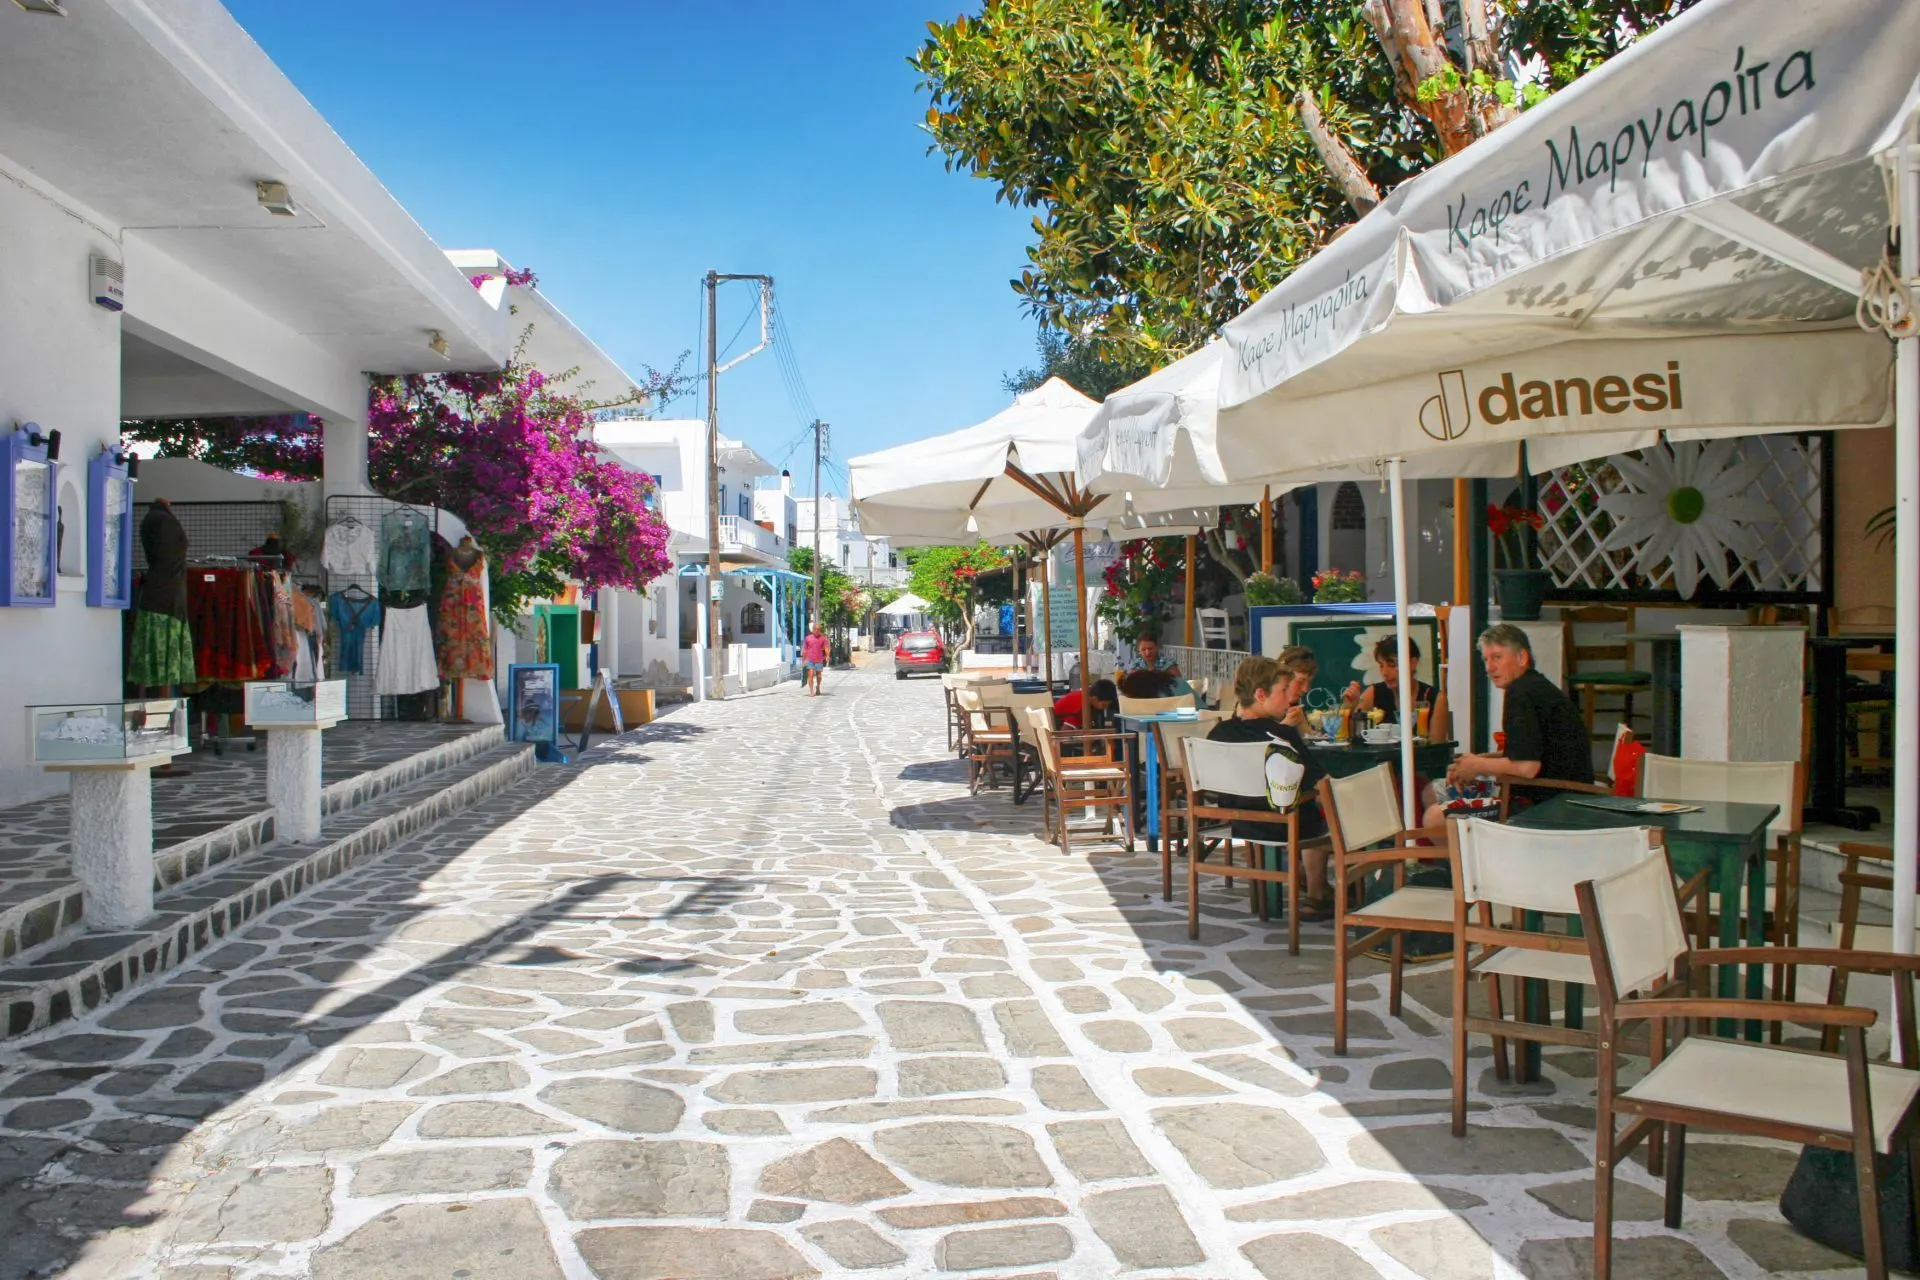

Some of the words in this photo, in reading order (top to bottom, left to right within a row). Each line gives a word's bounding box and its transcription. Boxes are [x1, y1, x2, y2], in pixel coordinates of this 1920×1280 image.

[1447, 180, 1532, 254] Καφε
[1542, 46, 1815, 209] Μαργαρίτα
[1478, 360, 1682, 425] danesi
